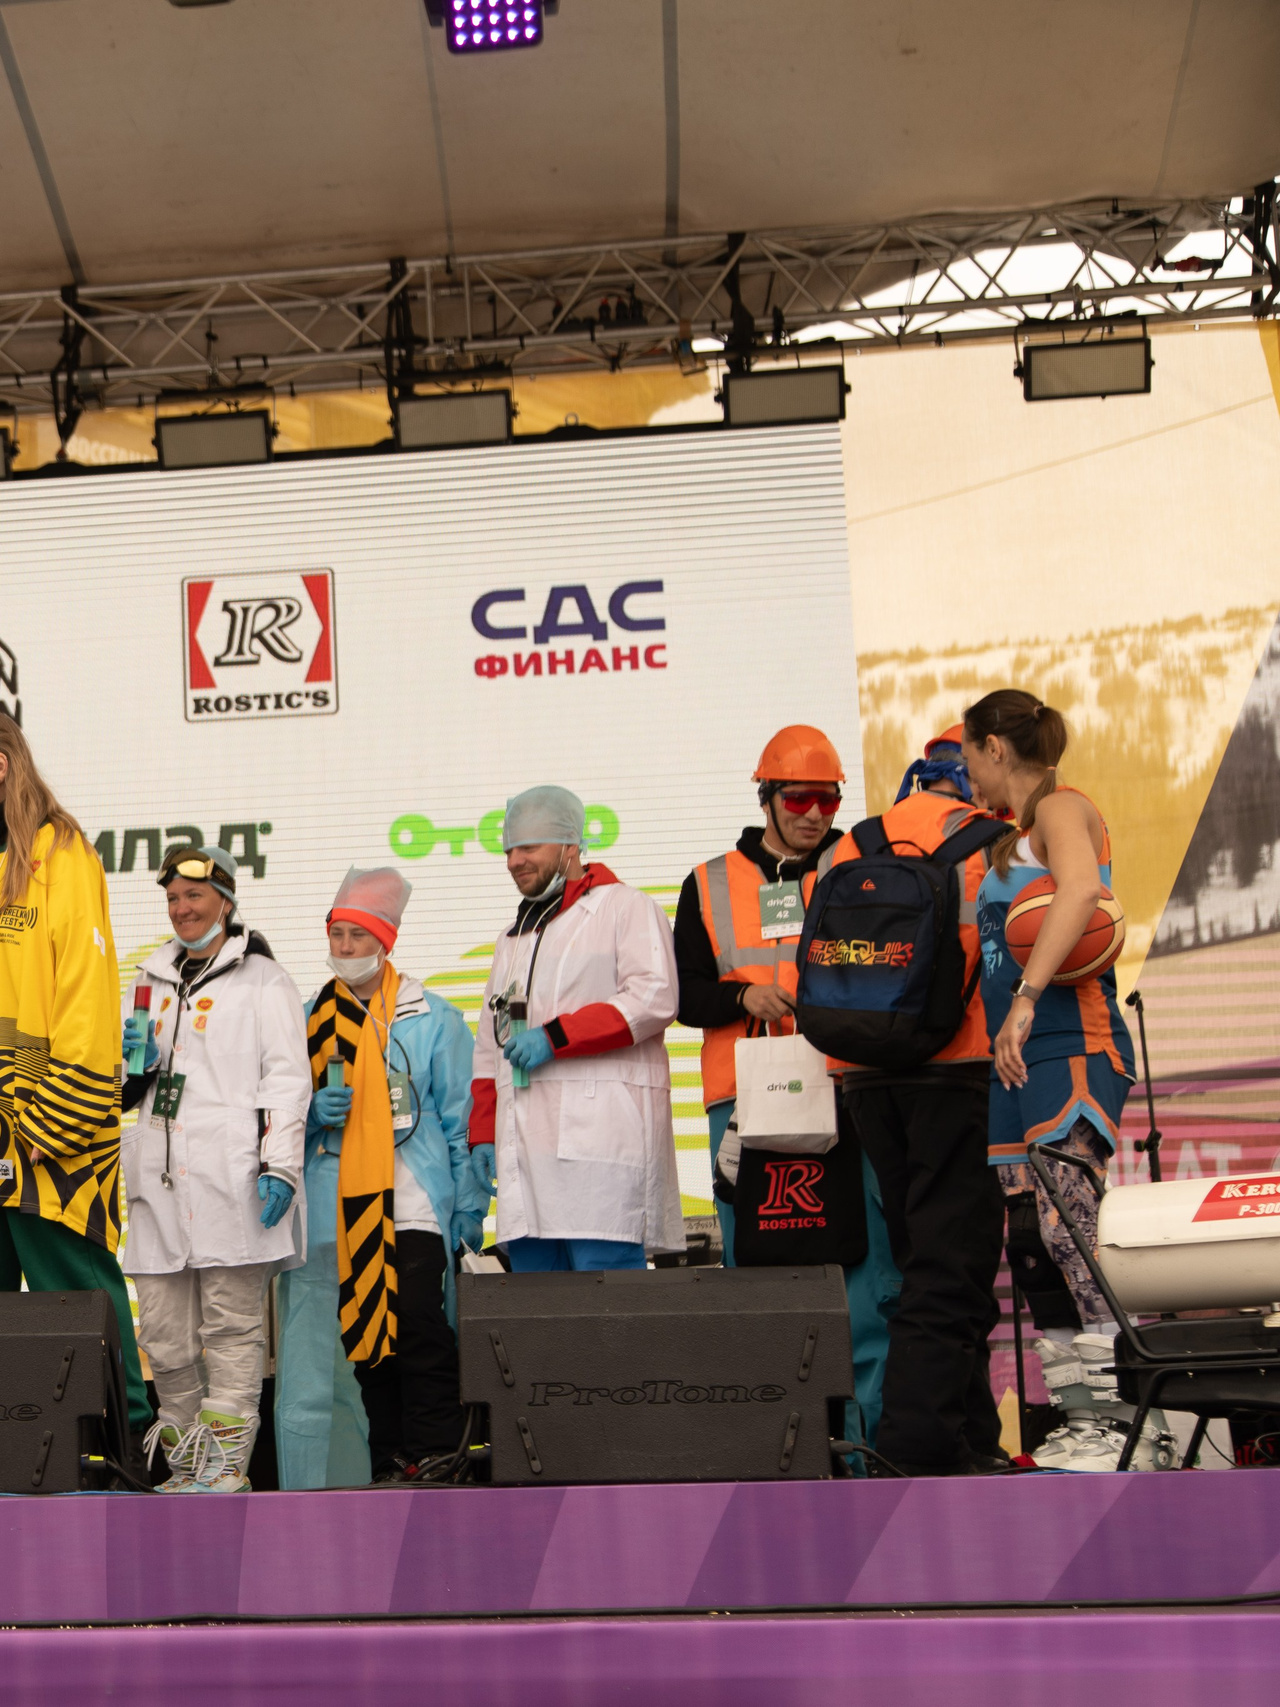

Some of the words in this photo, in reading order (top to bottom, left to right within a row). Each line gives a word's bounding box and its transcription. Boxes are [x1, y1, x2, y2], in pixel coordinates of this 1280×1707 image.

[471, 579, 666, 645] СДС
[474, 644, 668, 679] ФИНАНС
[193, 690, 331, 715] ROSTIC'S
[0, 917, 19, 927] FEST
[775, 910, 790, 920] 42
[758, 1217, 827, 1230] ROSTIC'S
[527, 1380, 787, 1407] ProTone
